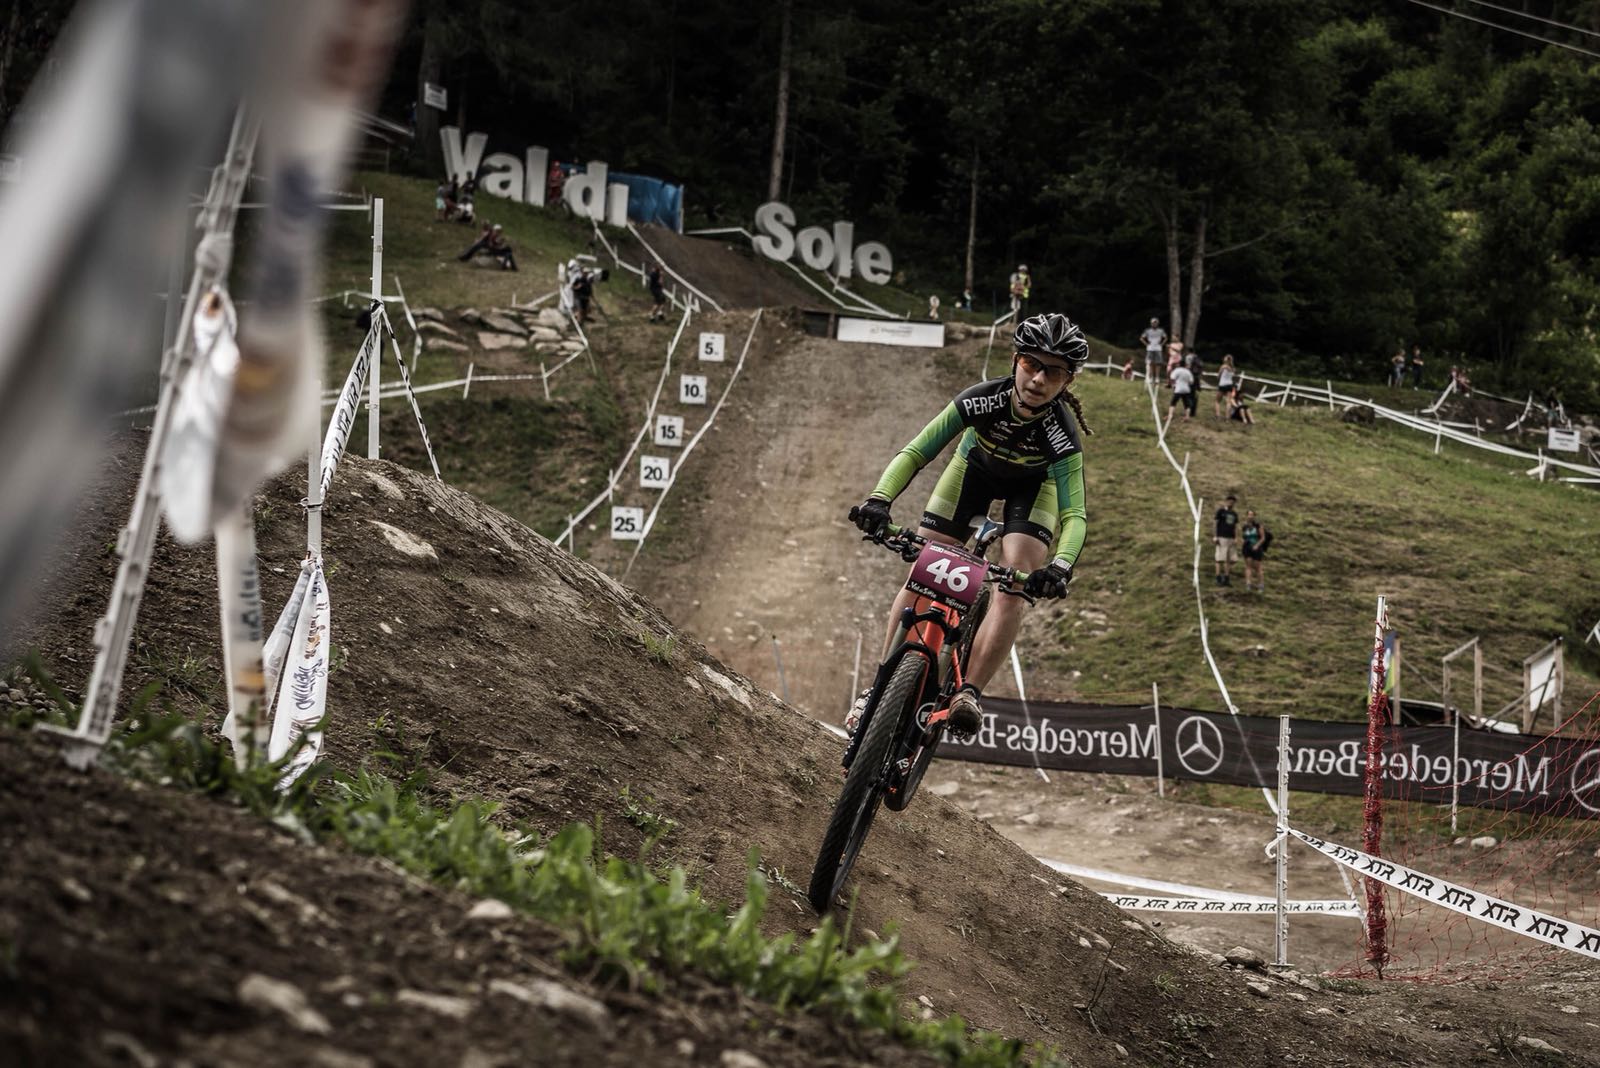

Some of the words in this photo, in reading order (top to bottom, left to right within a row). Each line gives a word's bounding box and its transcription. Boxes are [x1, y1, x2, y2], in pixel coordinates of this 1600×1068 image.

[439, 125, 549, 208] Val
[563, 160, 630, 228] di
[752, 202, 893, 285] Sole
[704, 341, 714, 356] 5
[685, 384, 700, 398] 10
[660, 424, 676, 440] 15
[643, 465, 663, 482] 20
[614, 516, 636, 533] 25
[926, 558, 971, 592] 46
[1114, 897, 1140, 907] XTR
[1143, 899, 1169, 910] XTR
[1173, 900, 1198, 911] XTR
[1201, 901, 1226, 912] XTR
[1229, 902, 1251, 912] XTR
[1255, 903, 1277, 912] XTR
[1360, 857, 1396, 881] XTR
[1398, 870, 1435, 897] XTR
[1438, 885, 1476, 912] XTR
[1480, 900, 1521, 928] XTR
[1525, 914, 1569, 944] XTR
[1574, 930, 1600, 953] XT
